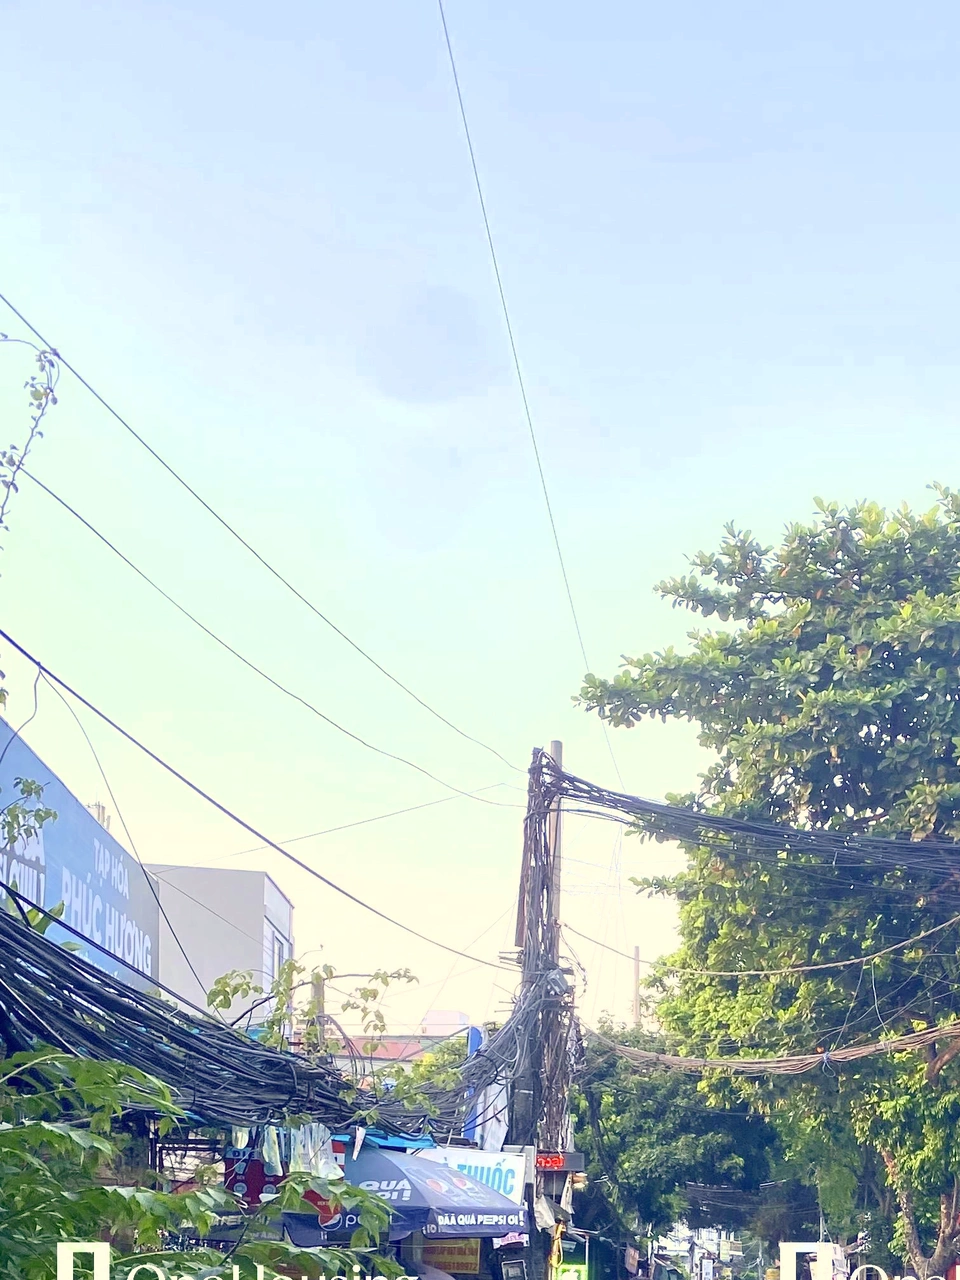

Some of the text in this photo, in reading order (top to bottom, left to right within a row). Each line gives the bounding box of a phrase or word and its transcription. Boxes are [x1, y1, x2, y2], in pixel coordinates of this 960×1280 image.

[94, 838, 111, 886] TẠP
[111, 855, 130, 900] HÓA
[62, 865, 103, 943] PHÚC
[105, 903, 152, 975] HƯƠNG
